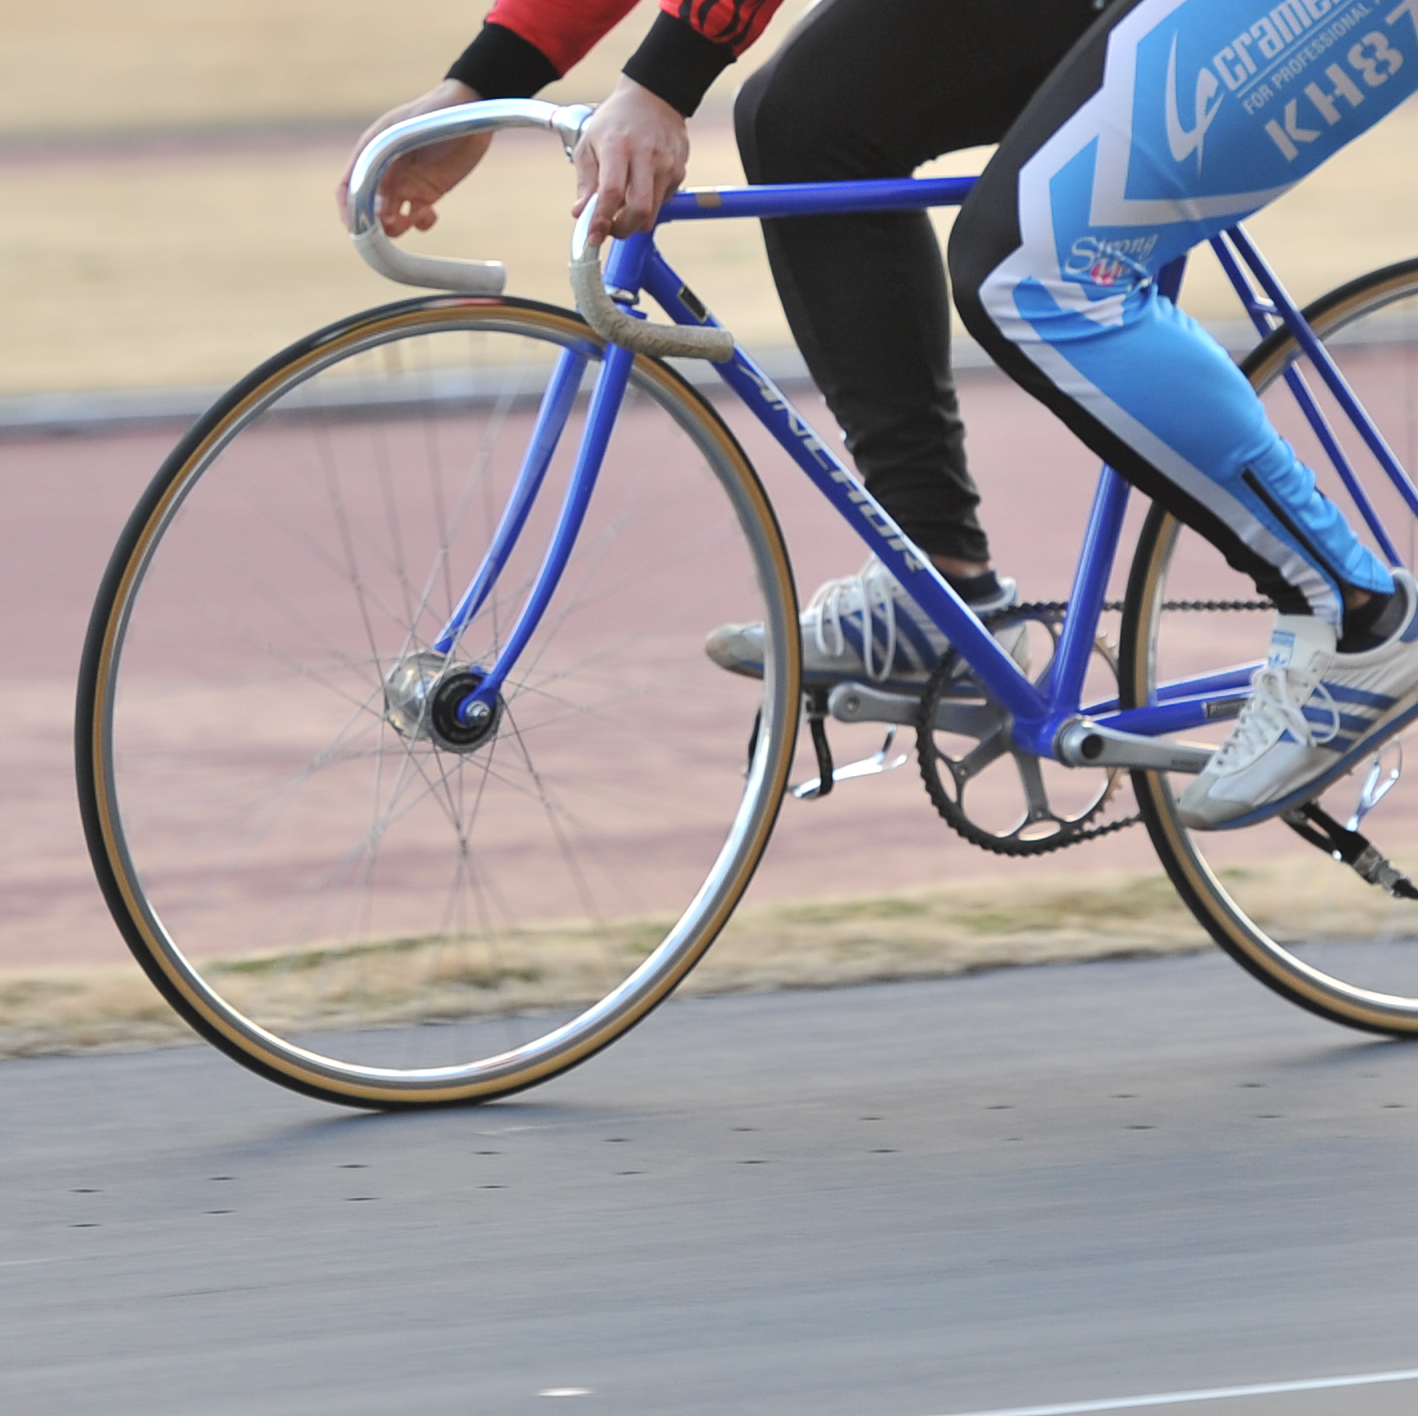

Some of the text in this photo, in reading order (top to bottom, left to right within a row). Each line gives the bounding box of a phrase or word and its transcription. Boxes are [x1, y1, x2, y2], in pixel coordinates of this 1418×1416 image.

[1242, 83, 1275, 116] FOR
[1271, 2, 1373, 90] PROFESSIONAL
[737, 362, 927, 573] ANCHOR
